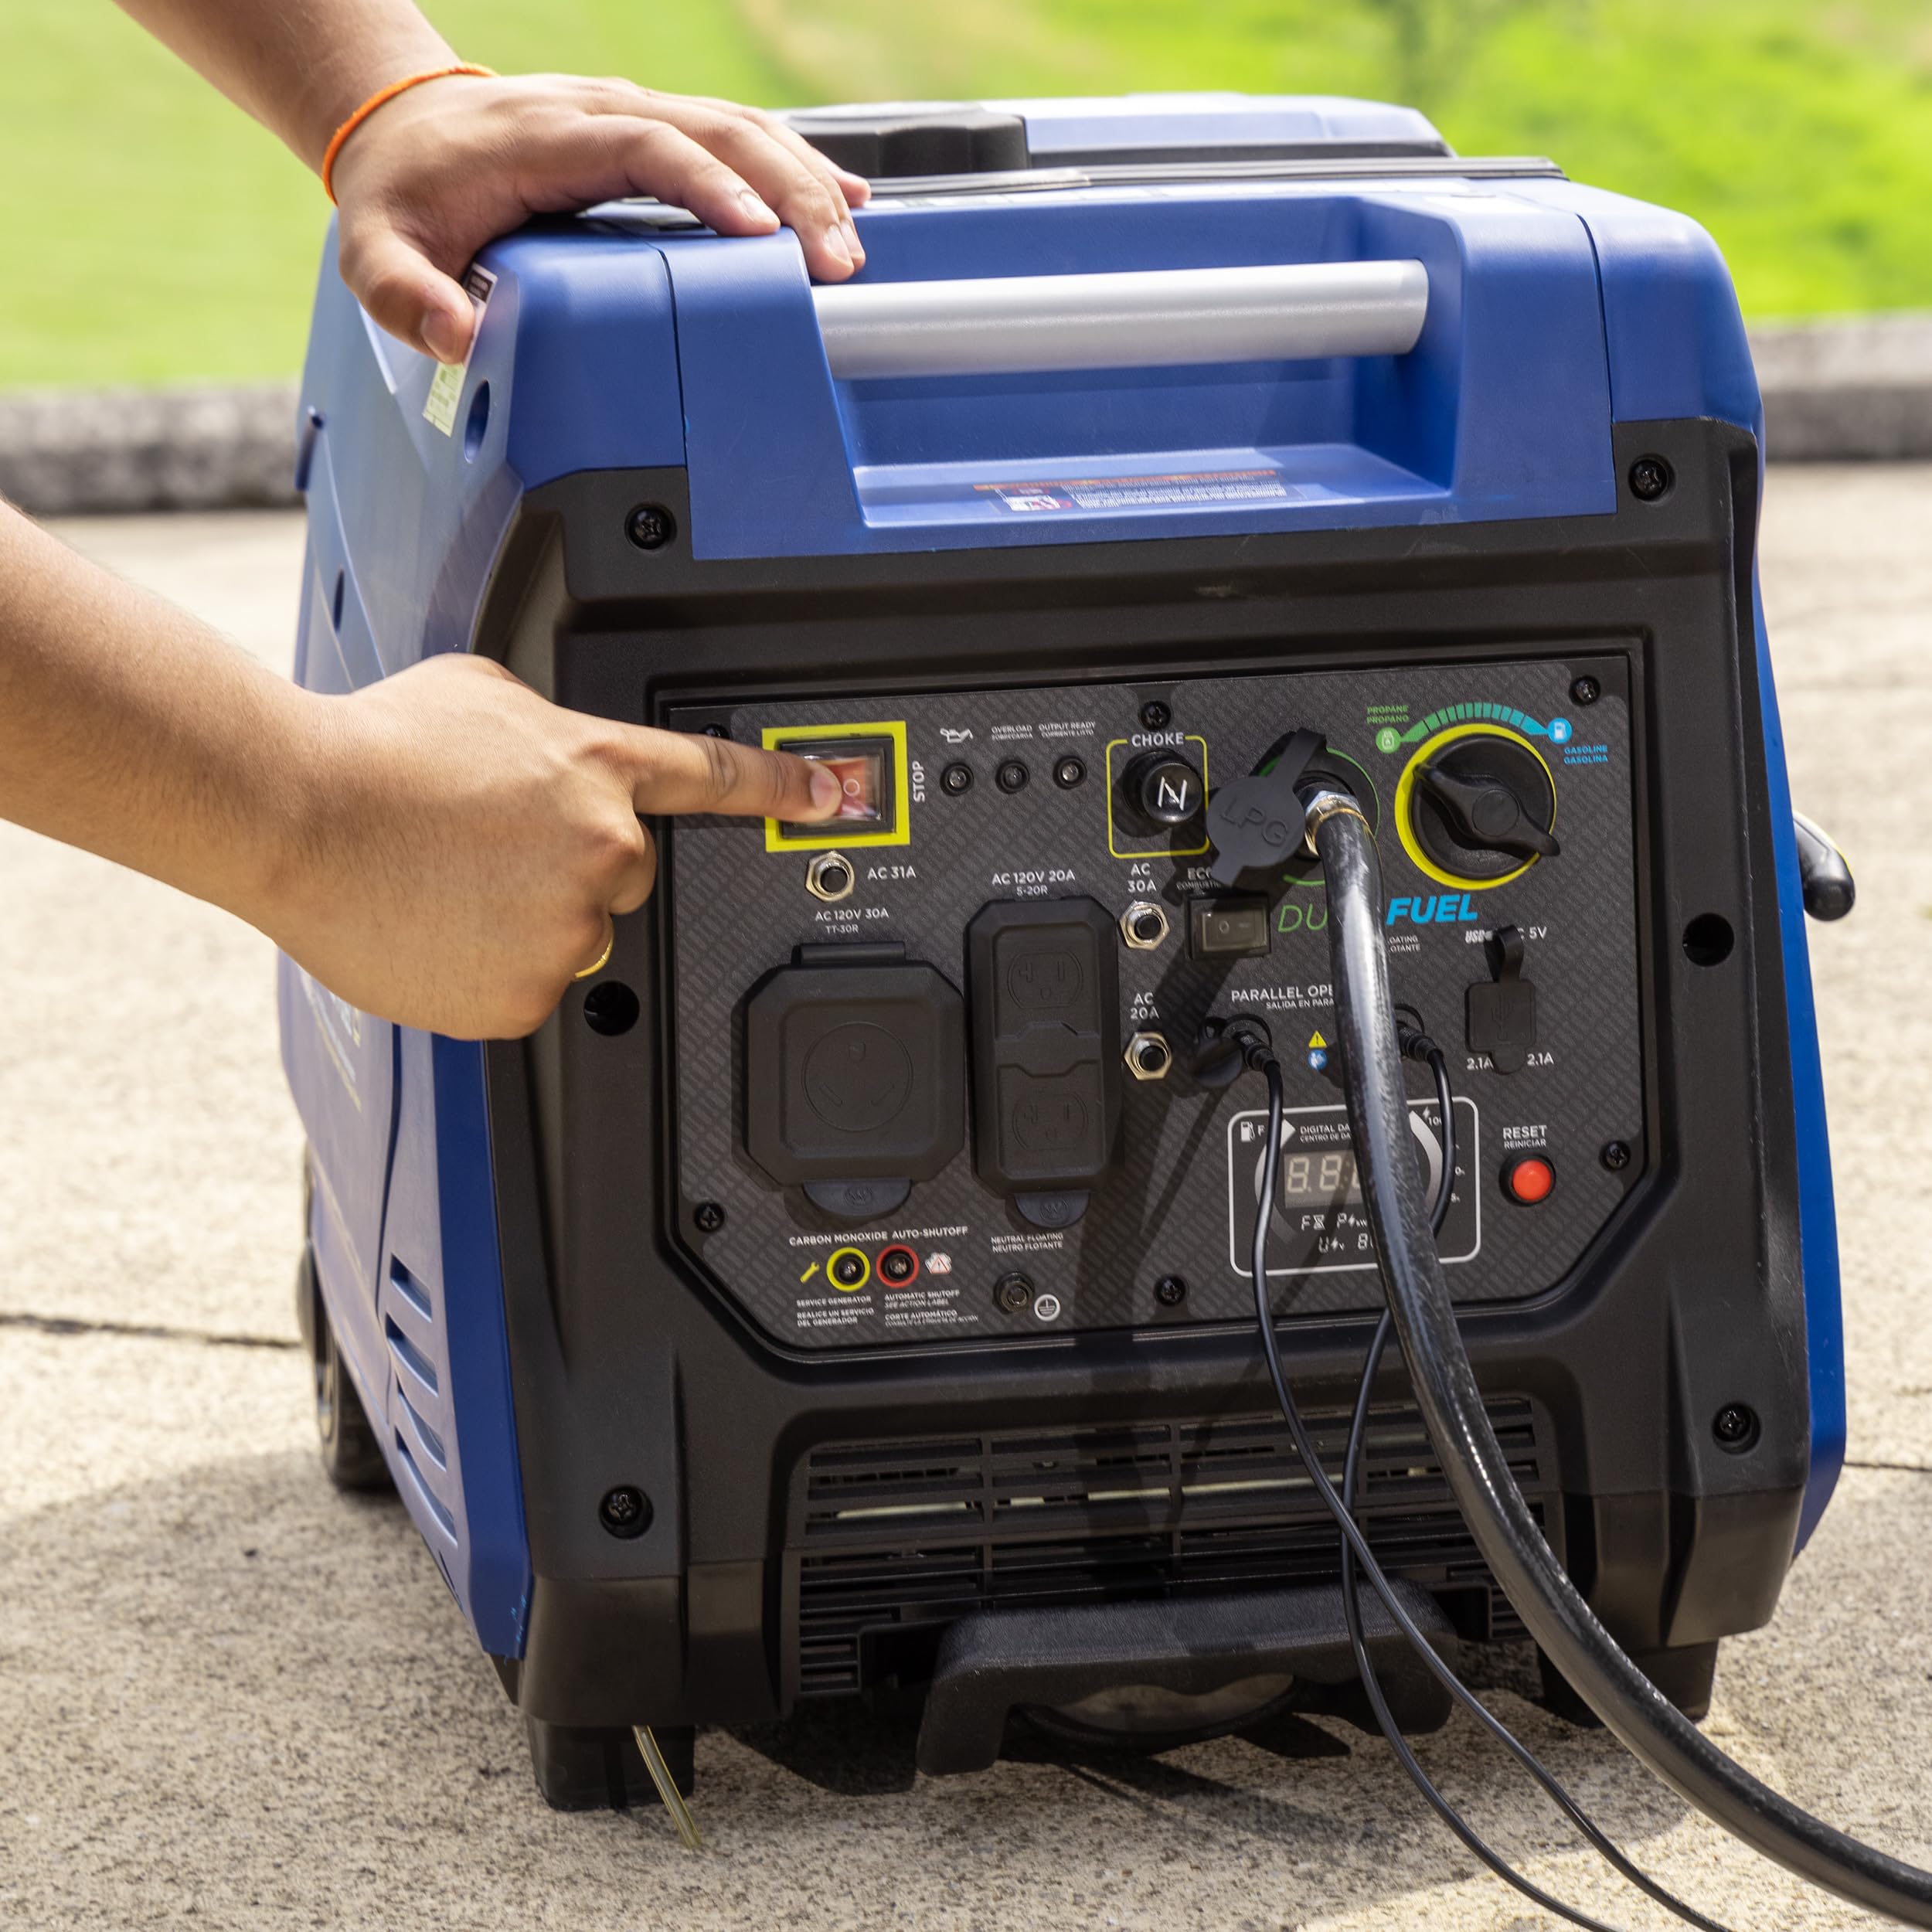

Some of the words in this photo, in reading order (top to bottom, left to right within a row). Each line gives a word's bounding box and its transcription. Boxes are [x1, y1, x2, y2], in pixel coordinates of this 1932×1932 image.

[1367, 705, 1408, 714] PROPANE
[1366, 715, 1410, 724] PROPANO
[991, 725, 1032, 733] OVERLOAD
[1038, 723, 1068, 732] OUTPUT
[1070, 721, 1096, 730] READY
[1131, 733, 1184, 747] CHOKE
[1564, 744, 1608, 754] GASOLINE
[1563, 754, 1608, 765] GASOLINA
[913, 760, 926, 803] STOP
[1219, 796, 1289, 847] LPG
[867, 868, 889, 880] AC
[892, 866, 917, 879] 31A
[1131, 863, 1151, 876] AC
[992, 873, 1012, 886] AC
[1014, 872, 1045, 884] 120V
[1049, 870, 1076, 883] 20A
[1016, 886, 1048, 896] 5-20R
[1128, 879, 1157, 893] 30A
[815, 911, 832, 922] AC
[833, 909, 862, 921] 120V
[865, 907, 889, 920] 30A
[1386, 894, 1478, 926] FUEL
[825, 923, 859, 934] TT-30R
[1529, 927, 1547, 940] 5V
[1389, 935, 1419, 944] OATING
[1389, 944, 1420, 953] OTANTE
[1134, 992, 1154, 1005] AC
[1231, 985, 1304, 1002] PARALLEL
[1266, 1001, 1298, 1010] SALIDA
[1298, 999, 1311, 1009] EN
[1130, 1008, 1159, 1020] 20A
[1467, 1057, 1495, 1070] 2.1A
[1527, 1052, 1555, 1066] 2.1A
[1300, 1124, 1334, 1134] DIGITAL
[1503, 1125, 1547, 1140] RESET
[1301, 1134, 1328, 1143] CENTRO
[1504, 1139, 1546, 1149] REINICIAR
[789, 1234, 832, 1247] CARBON
[834, 1231, 888, 1243] MONOXIDE
[892, 1226, 969, 1240] AUTO-SHUTOFF
[991, 1235, 1025, 1244] NEUTRAL
[1027, 1232, 1063, 1241] FLOATING
[992, 1243, 1024, 1253] NEUTRO
[1025, 1240, 1063, 1250] FLOTANTE
[884, 1291, 926, 1301] AUTOMATIC
[927, 1289, 960, 1298] SHUTOFF
[797, 1298, 827, 1308] SERVICE
[828, 1295, 872, 1305] GENERATOR
[884, 1301, 898, 1310] SEE
[900, 1299, 926, 1308] ACTION
[797, 1311, 827, 1319] REALICE
[840, 1308, 875, 1316] SERVICIO
[885, 1312, 909, 1321] CORTE
[797, 1319, 811, 1328] DEL
[812, 1316, 858, 1326] GENERADOR
